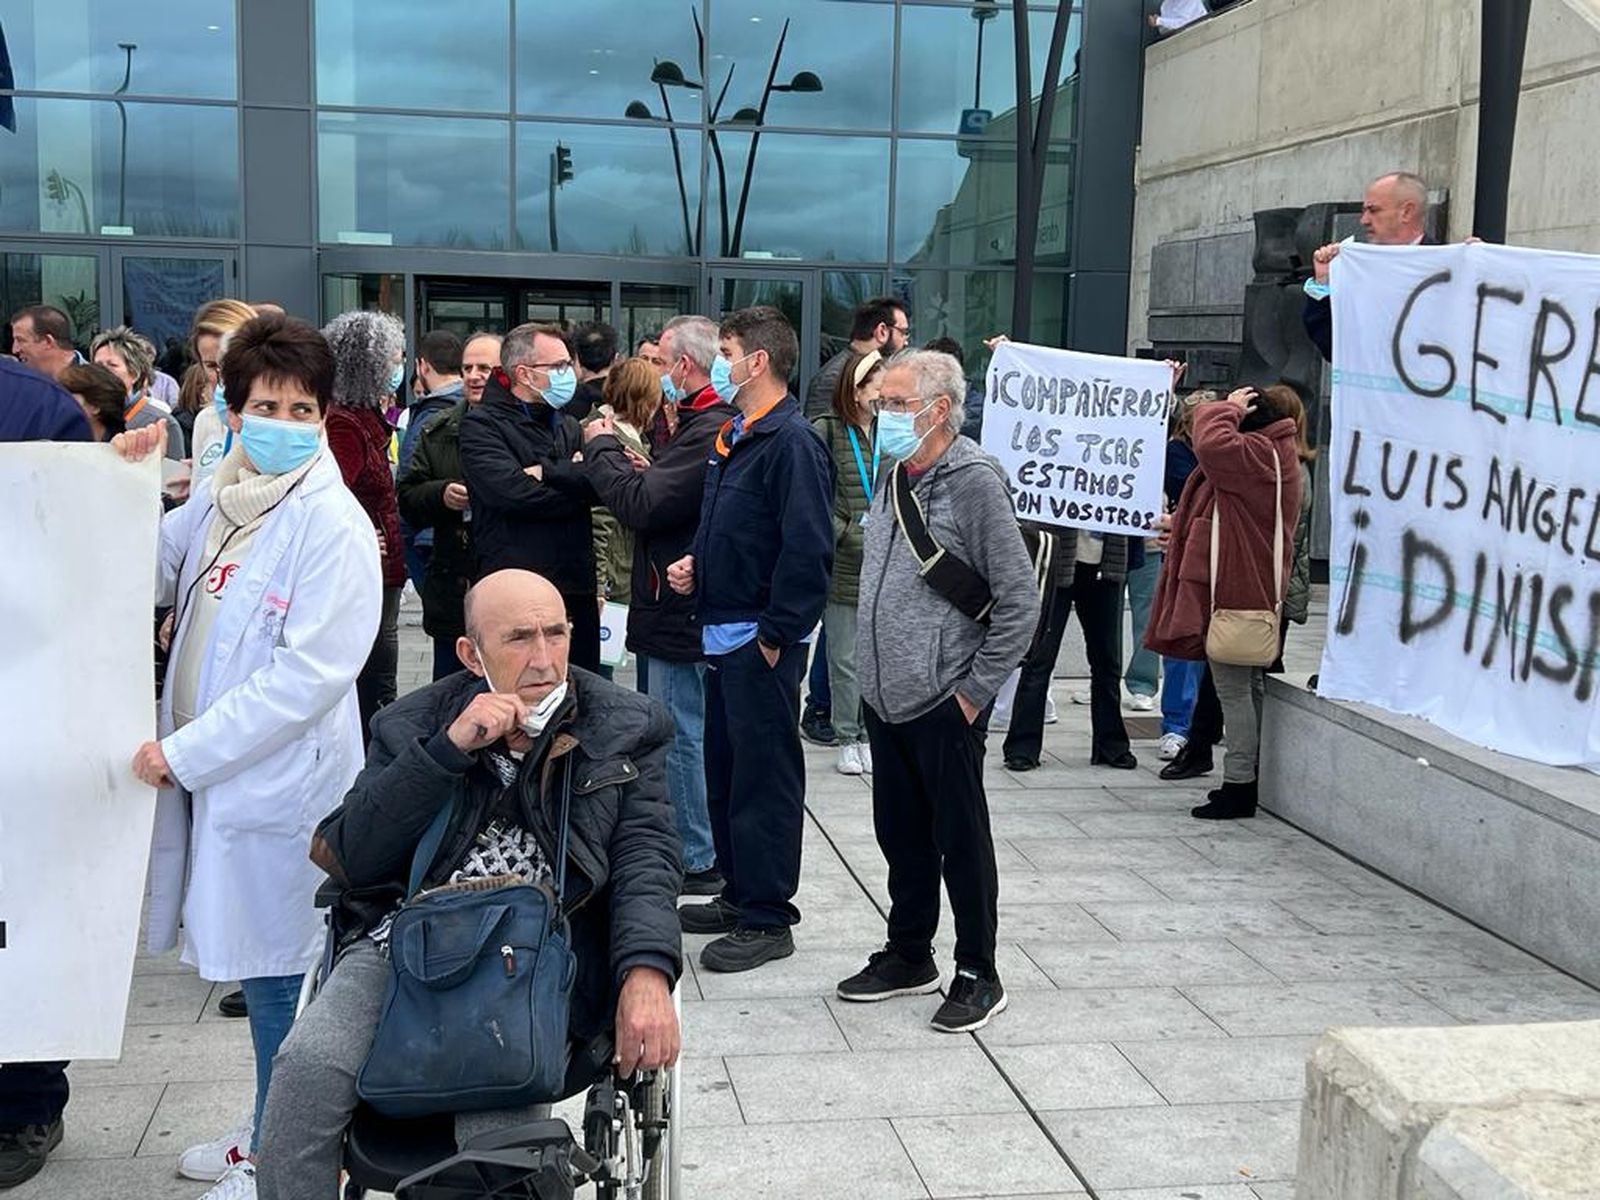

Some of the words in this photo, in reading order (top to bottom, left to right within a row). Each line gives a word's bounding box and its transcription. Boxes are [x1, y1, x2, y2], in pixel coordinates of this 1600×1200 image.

[991, 367, 1169, 427] ¡COMPAÑEROS!
[1011, 421, 1062, 457] LOS
[1076, 433, 1144, 468] TCAE
[1018, 460, 1136, 500] ESTAMOS
[1344, 430, 1468, 510] LUIS
[1482, 455, 1600, 562] ANGEL
[1050, 496, 1155, 529] VOSOTROS
